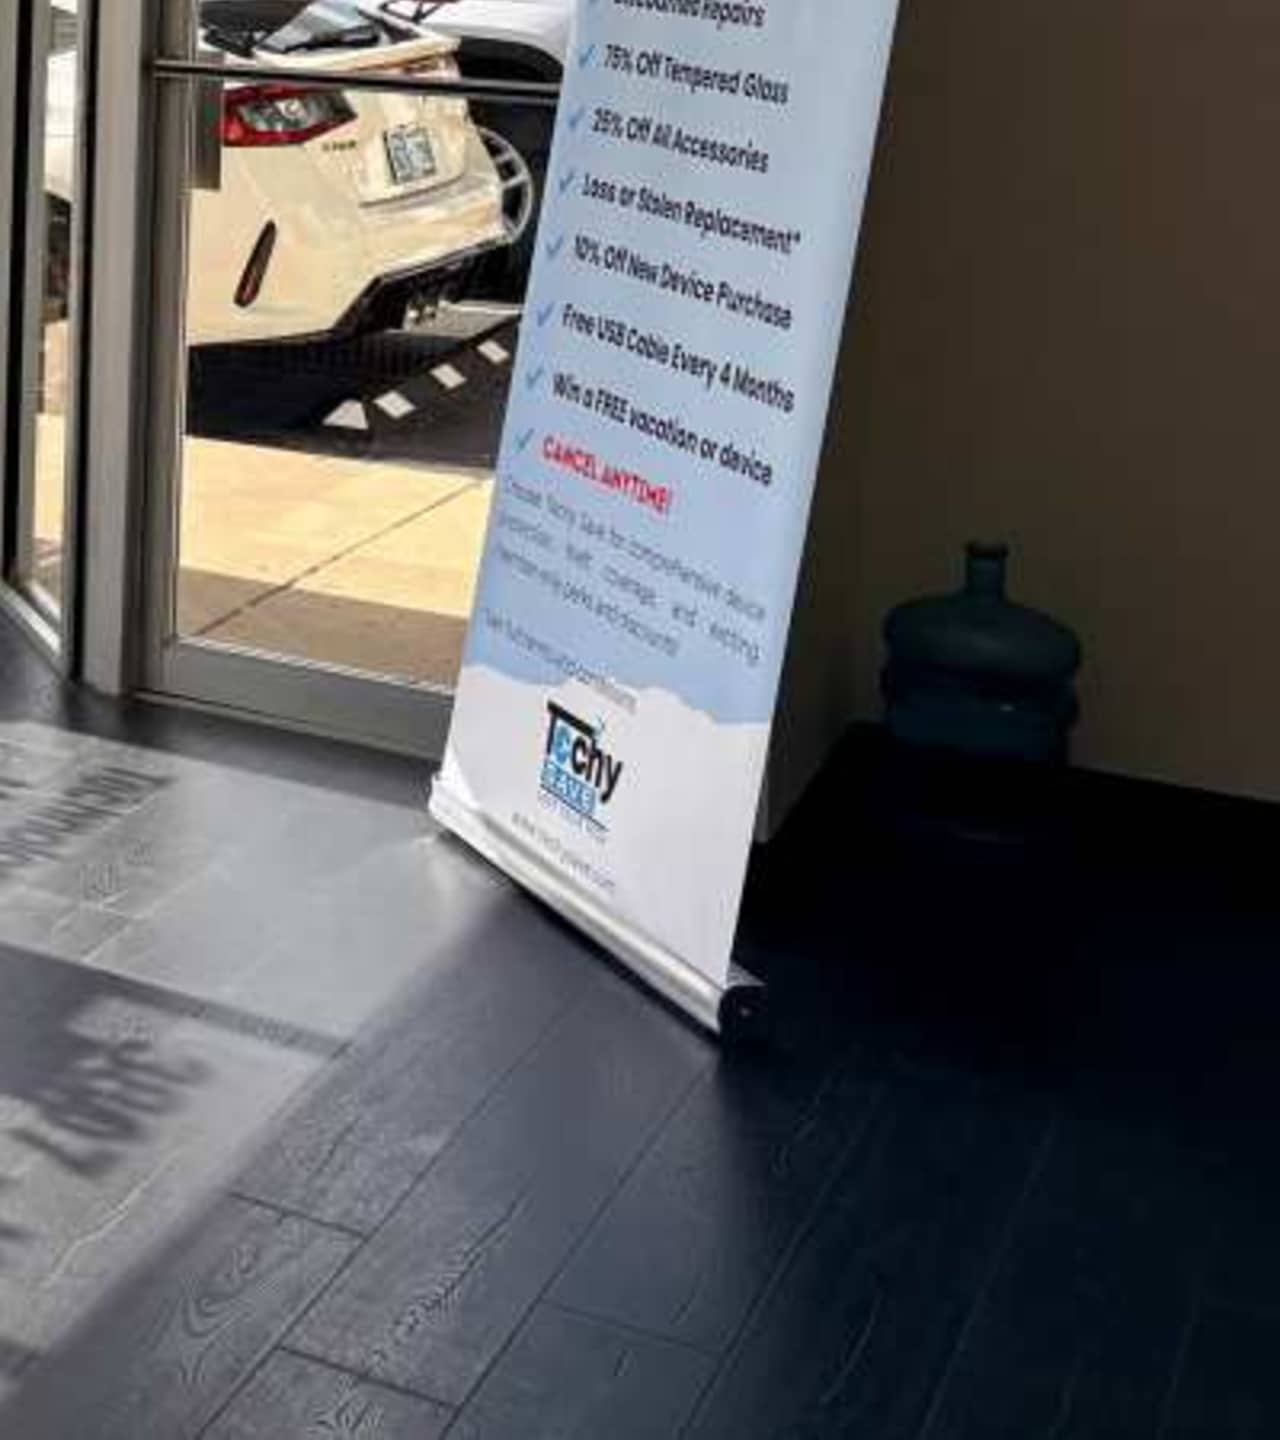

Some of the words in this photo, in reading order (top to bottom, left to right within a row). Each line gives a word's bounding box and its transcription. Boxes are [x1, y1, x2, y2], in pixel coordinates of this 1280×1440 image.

[605, 44, 633, 73] 75%
[637, 49, 662, 77] Off
[665, 56, 741, 94] Tempered
[743, 72, 789, 105] Glass
[593, 107, 623, 138] 25%
[627, 116, 652, 142] Off
[652, 123, 672, 147] All
[672, 127, 770, 174] Accessories
[582, 173, 616, 203] Loss
[620, 185, 637, 206] or
[637, 187, 682, 221] Stolen
[574, 235, 600, 266] 10%
[604, 245, 627, 273] Off
[627, 253, 659, 284] New
[659, 264, 714, 302] Device
[716, 281, 792, 330] Purchase
[562, 303, 595, 336] Free
[597, 315, 626, 347] USB
[626, 328, 670, 364] Cable
[671, 343, 718, 392] Every
[719, 363, 731, 388] 4
[732, 363, 795, 413] Months
[552, 372, 581, 405] Win
[582, 389, 593, 408] a
[595, 388, 629, 424] FREE
[629, 408, 698, 455] vacation
[700, 434, 719, 460] or
[719, 443, 773, 486] device
[542, 434, 596, 481] CANCEL
[602, 466, 671, 514] ANYTIME!
[547, 700, 623, 803] Techy
